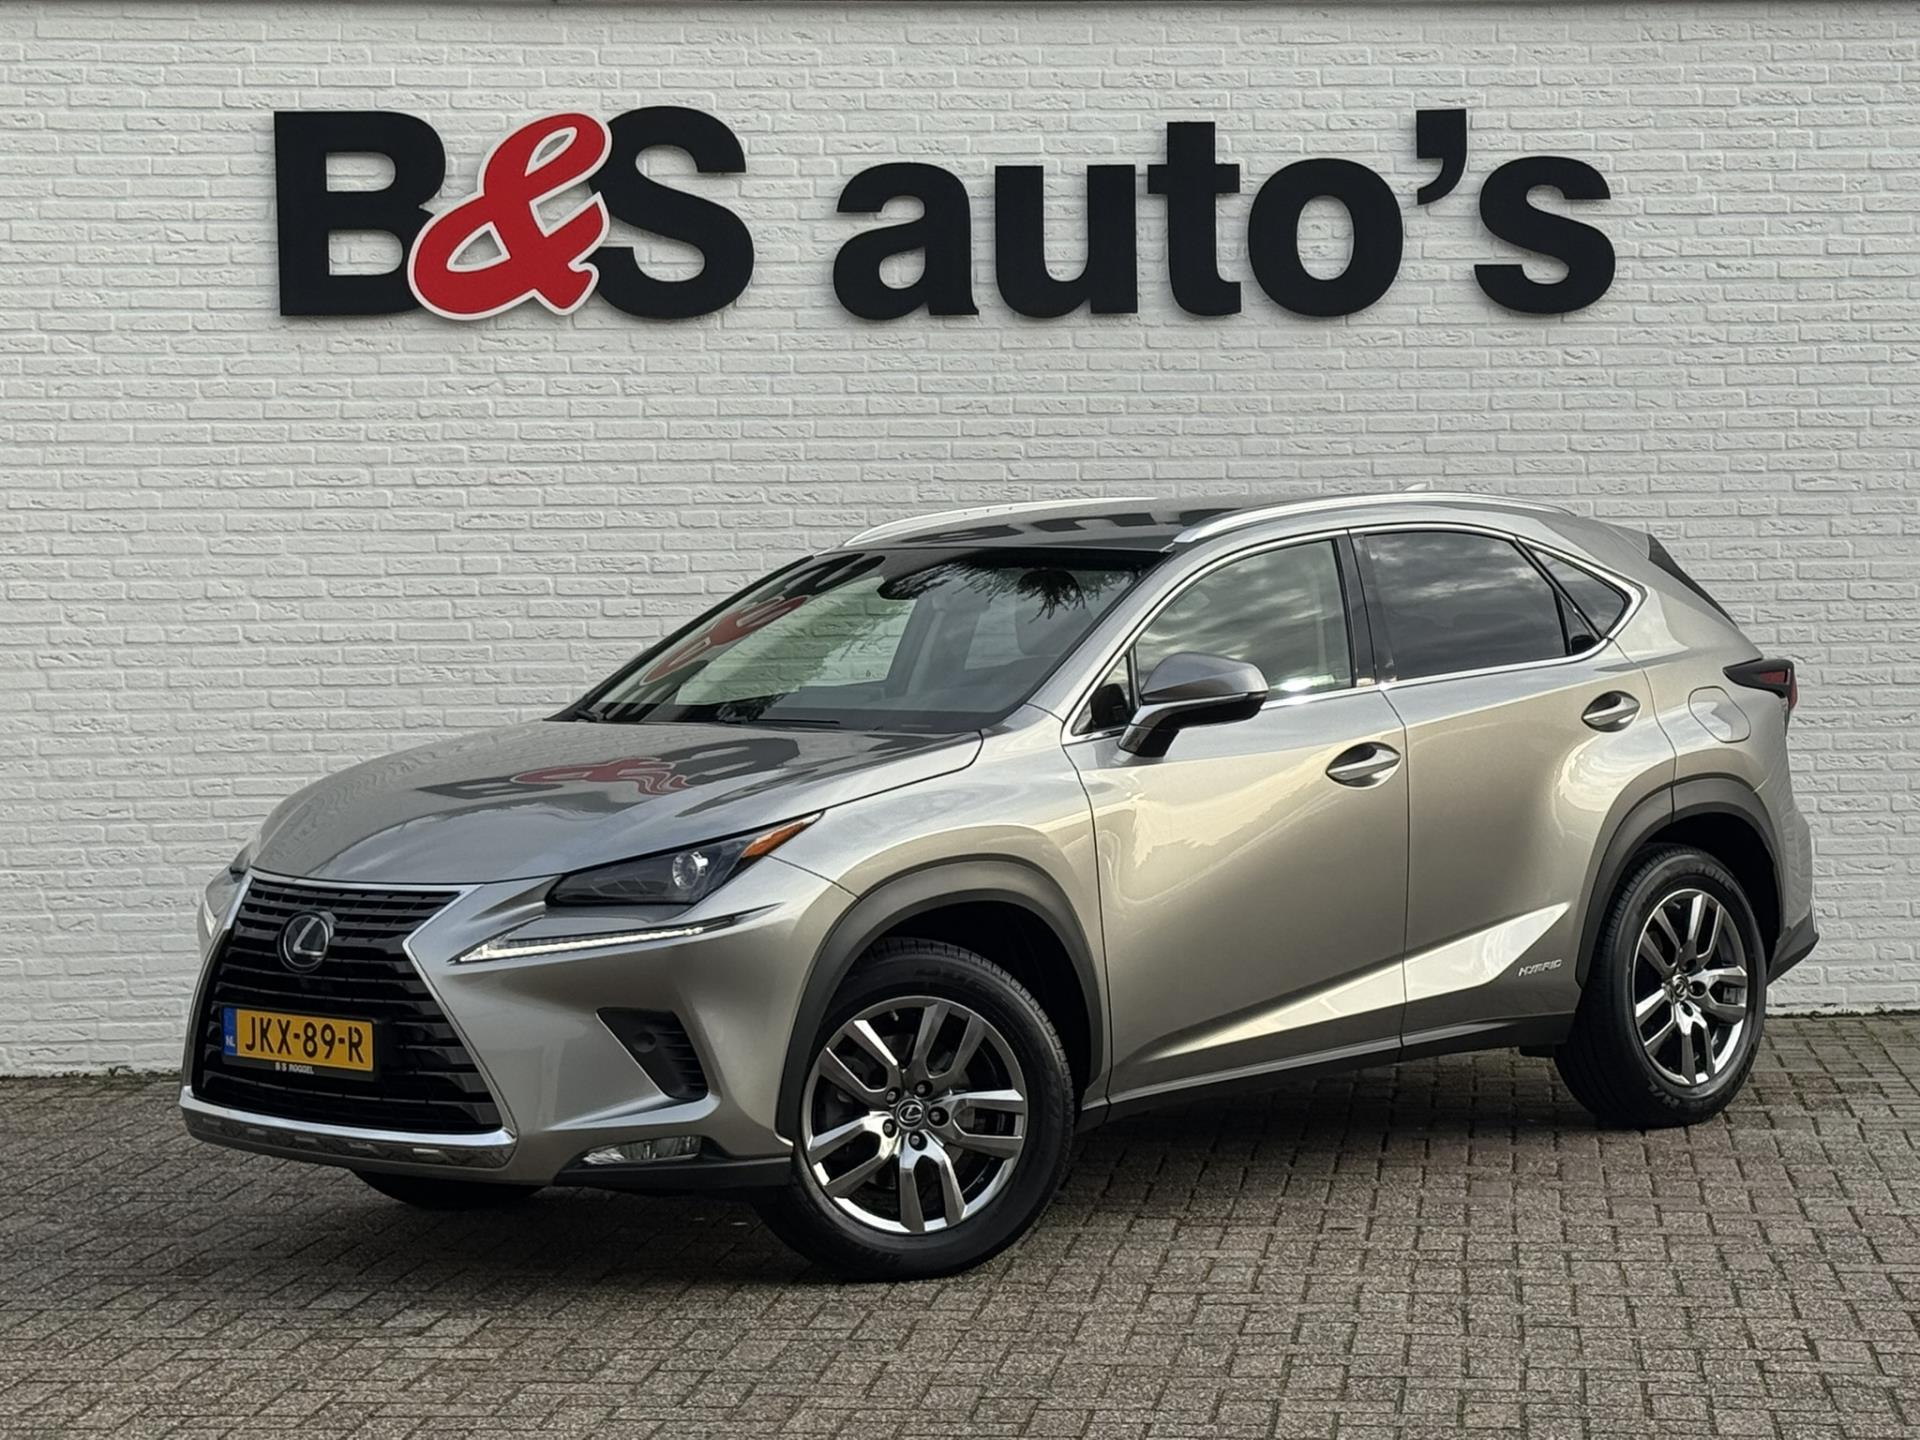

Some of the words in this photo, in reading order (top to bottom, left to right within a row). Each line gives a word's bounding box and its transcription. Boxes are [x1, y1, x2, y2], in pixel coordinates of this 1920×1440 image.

[273, 104, 755, 321] B&S
[832, 108, 1617, 321] auto's
[225, 1035, 236, 1047] NL
[245, 1016, 364, 1064] JKX-89-R
